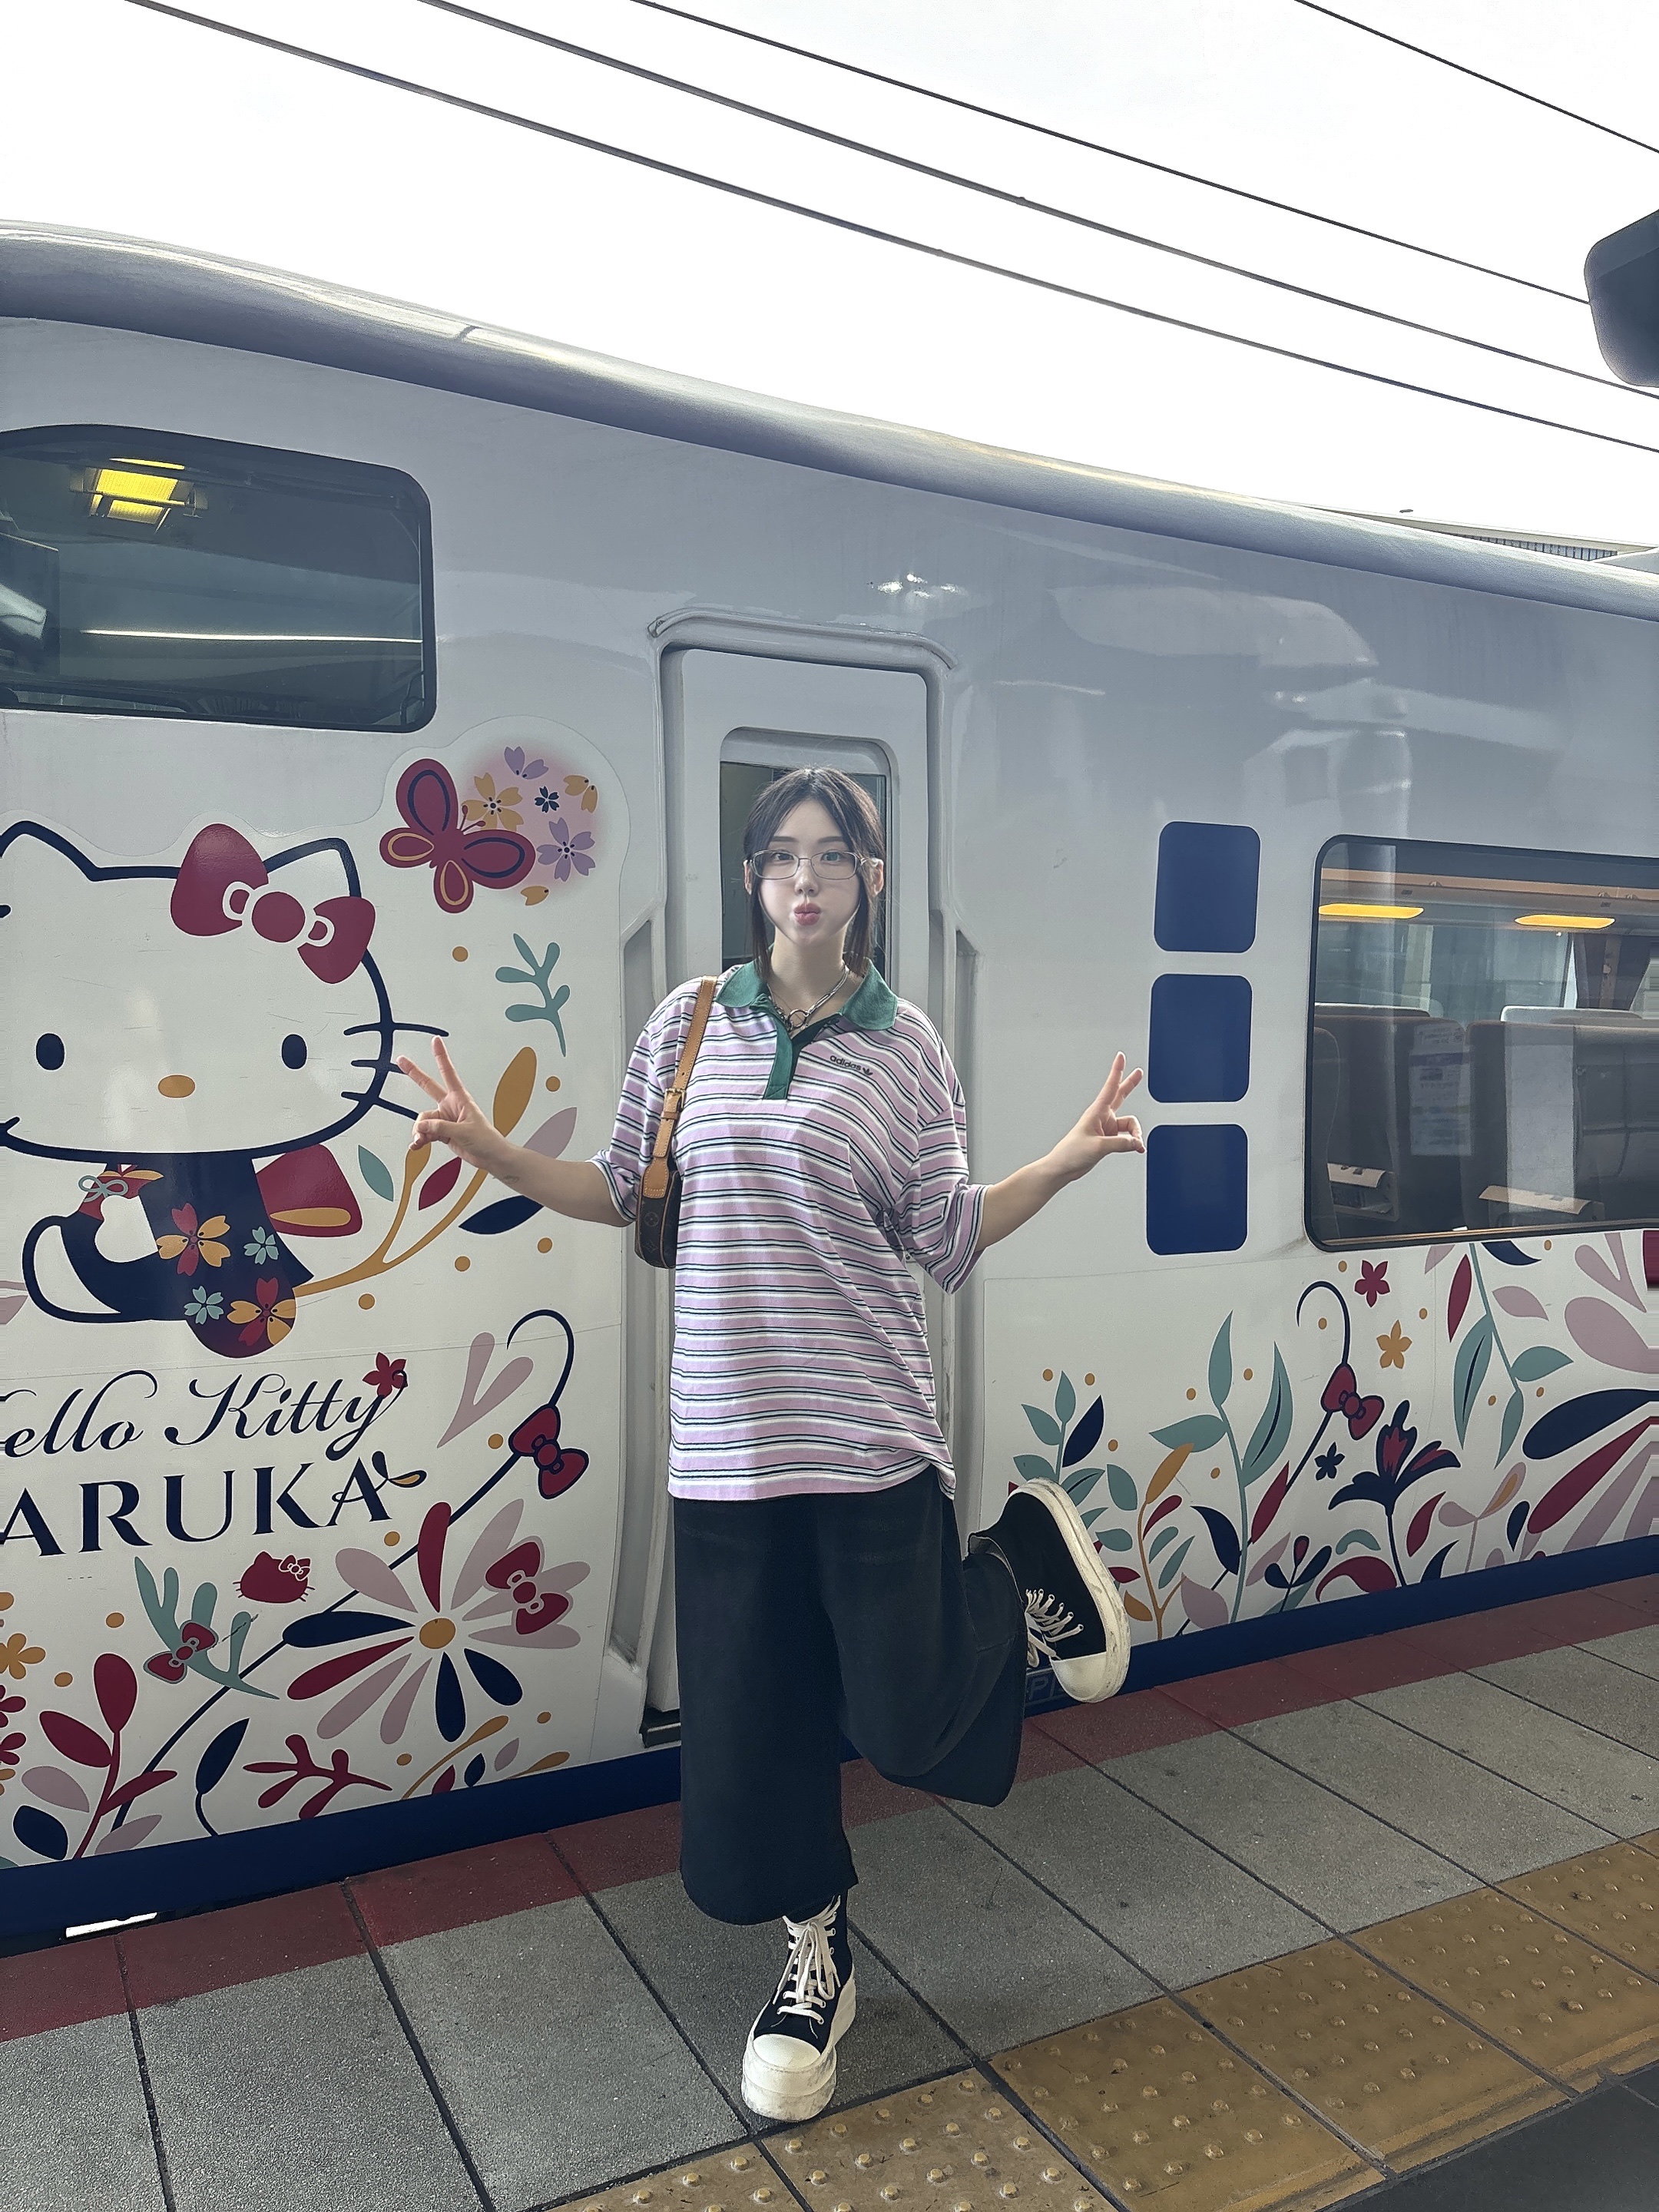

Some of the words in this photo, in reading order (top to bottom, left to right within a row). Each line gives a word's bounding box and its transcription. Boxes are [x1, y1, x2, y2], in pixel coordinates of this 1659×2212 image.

[830, 1055, 862, 1071] adidas
[0, 1369, 158, 1458] ello
[164, 1369, 408, 1461] Kitty
